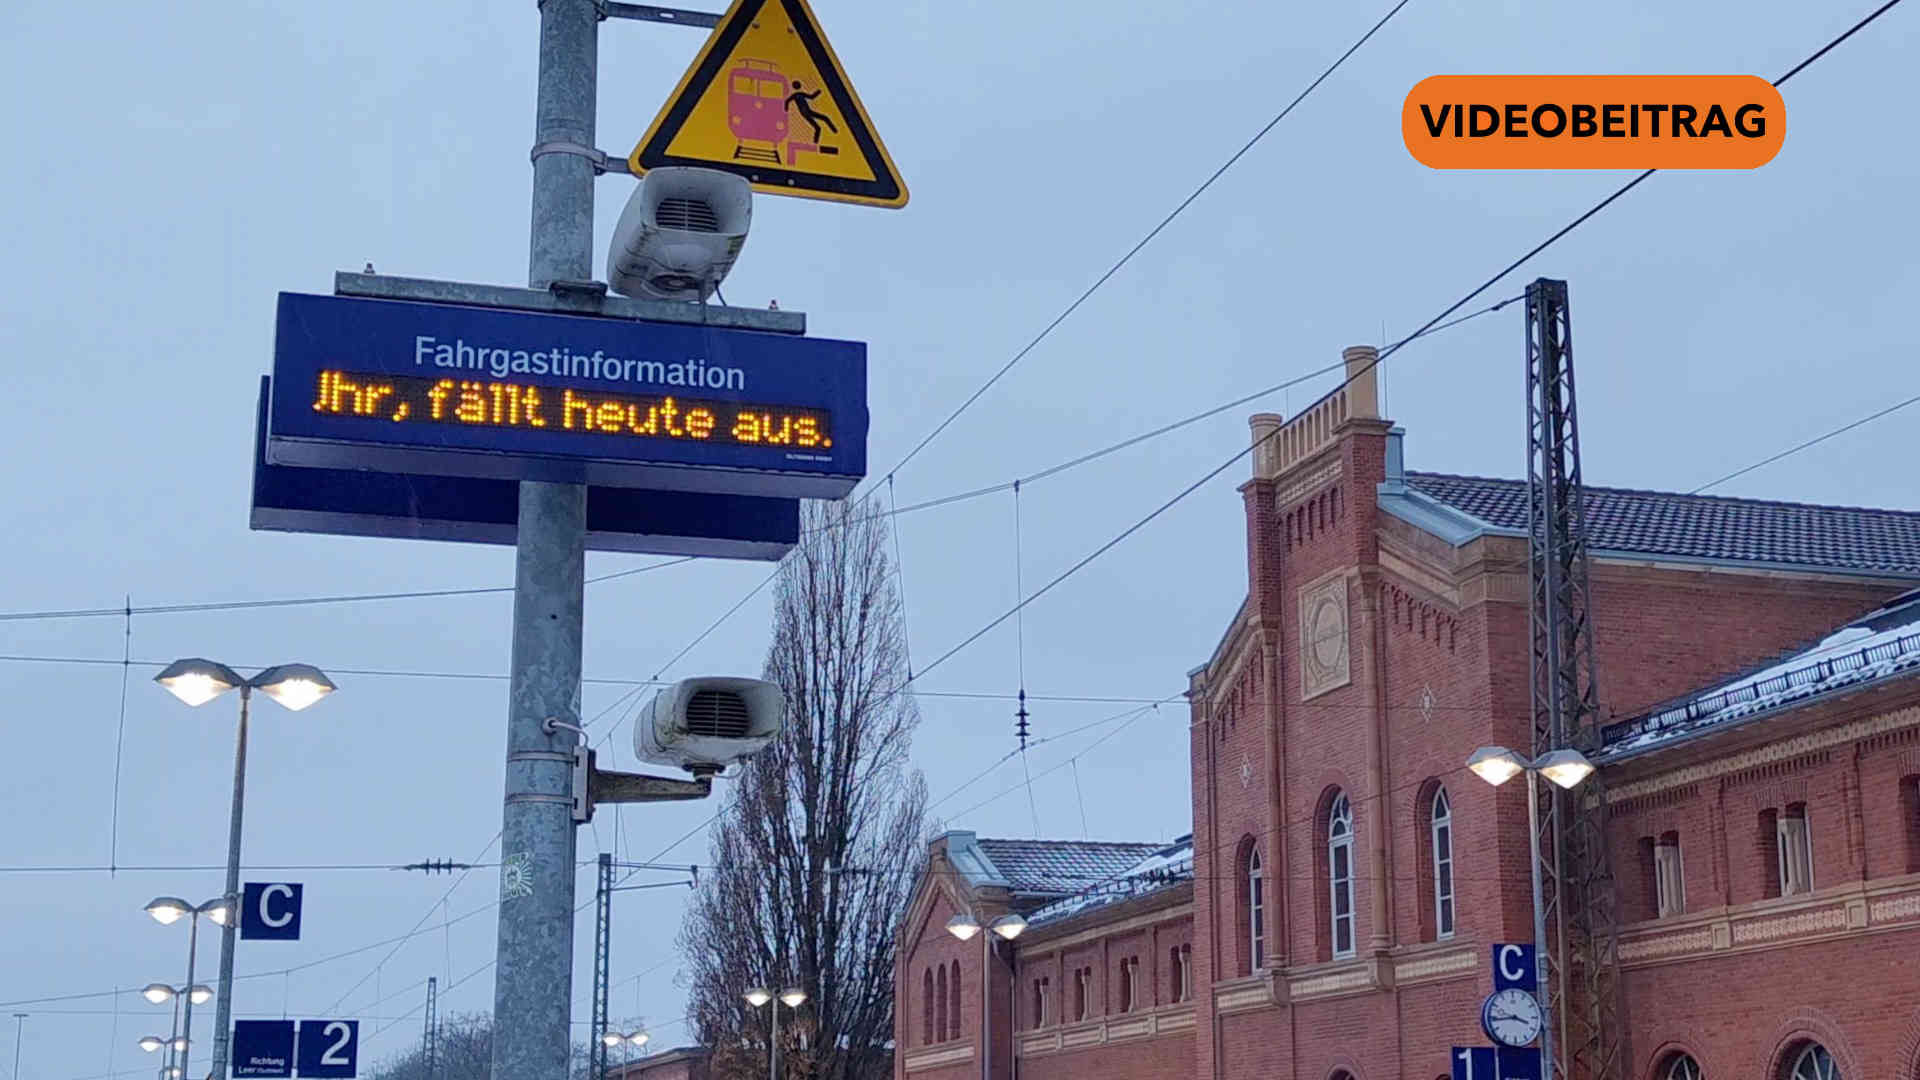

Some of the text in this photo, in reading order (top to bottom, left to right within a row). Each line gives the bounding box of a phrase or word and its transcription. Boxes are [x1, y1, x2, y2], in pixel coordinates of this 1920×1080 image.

[415, 335, 746, 391] Fahrgastinformation
[427, 377, 547, 427] fällt
[563, 389, 715, 438] heute
[732, 412, 833, 448] aus.
[259, 883, 294, 928] C
[1499, 944, 1525, 981] C
[250, 1057, 285, 1066] Richtung
[320, 1022, 351, 1065] 2
[1457, 1048, 1473, 1080] 1
